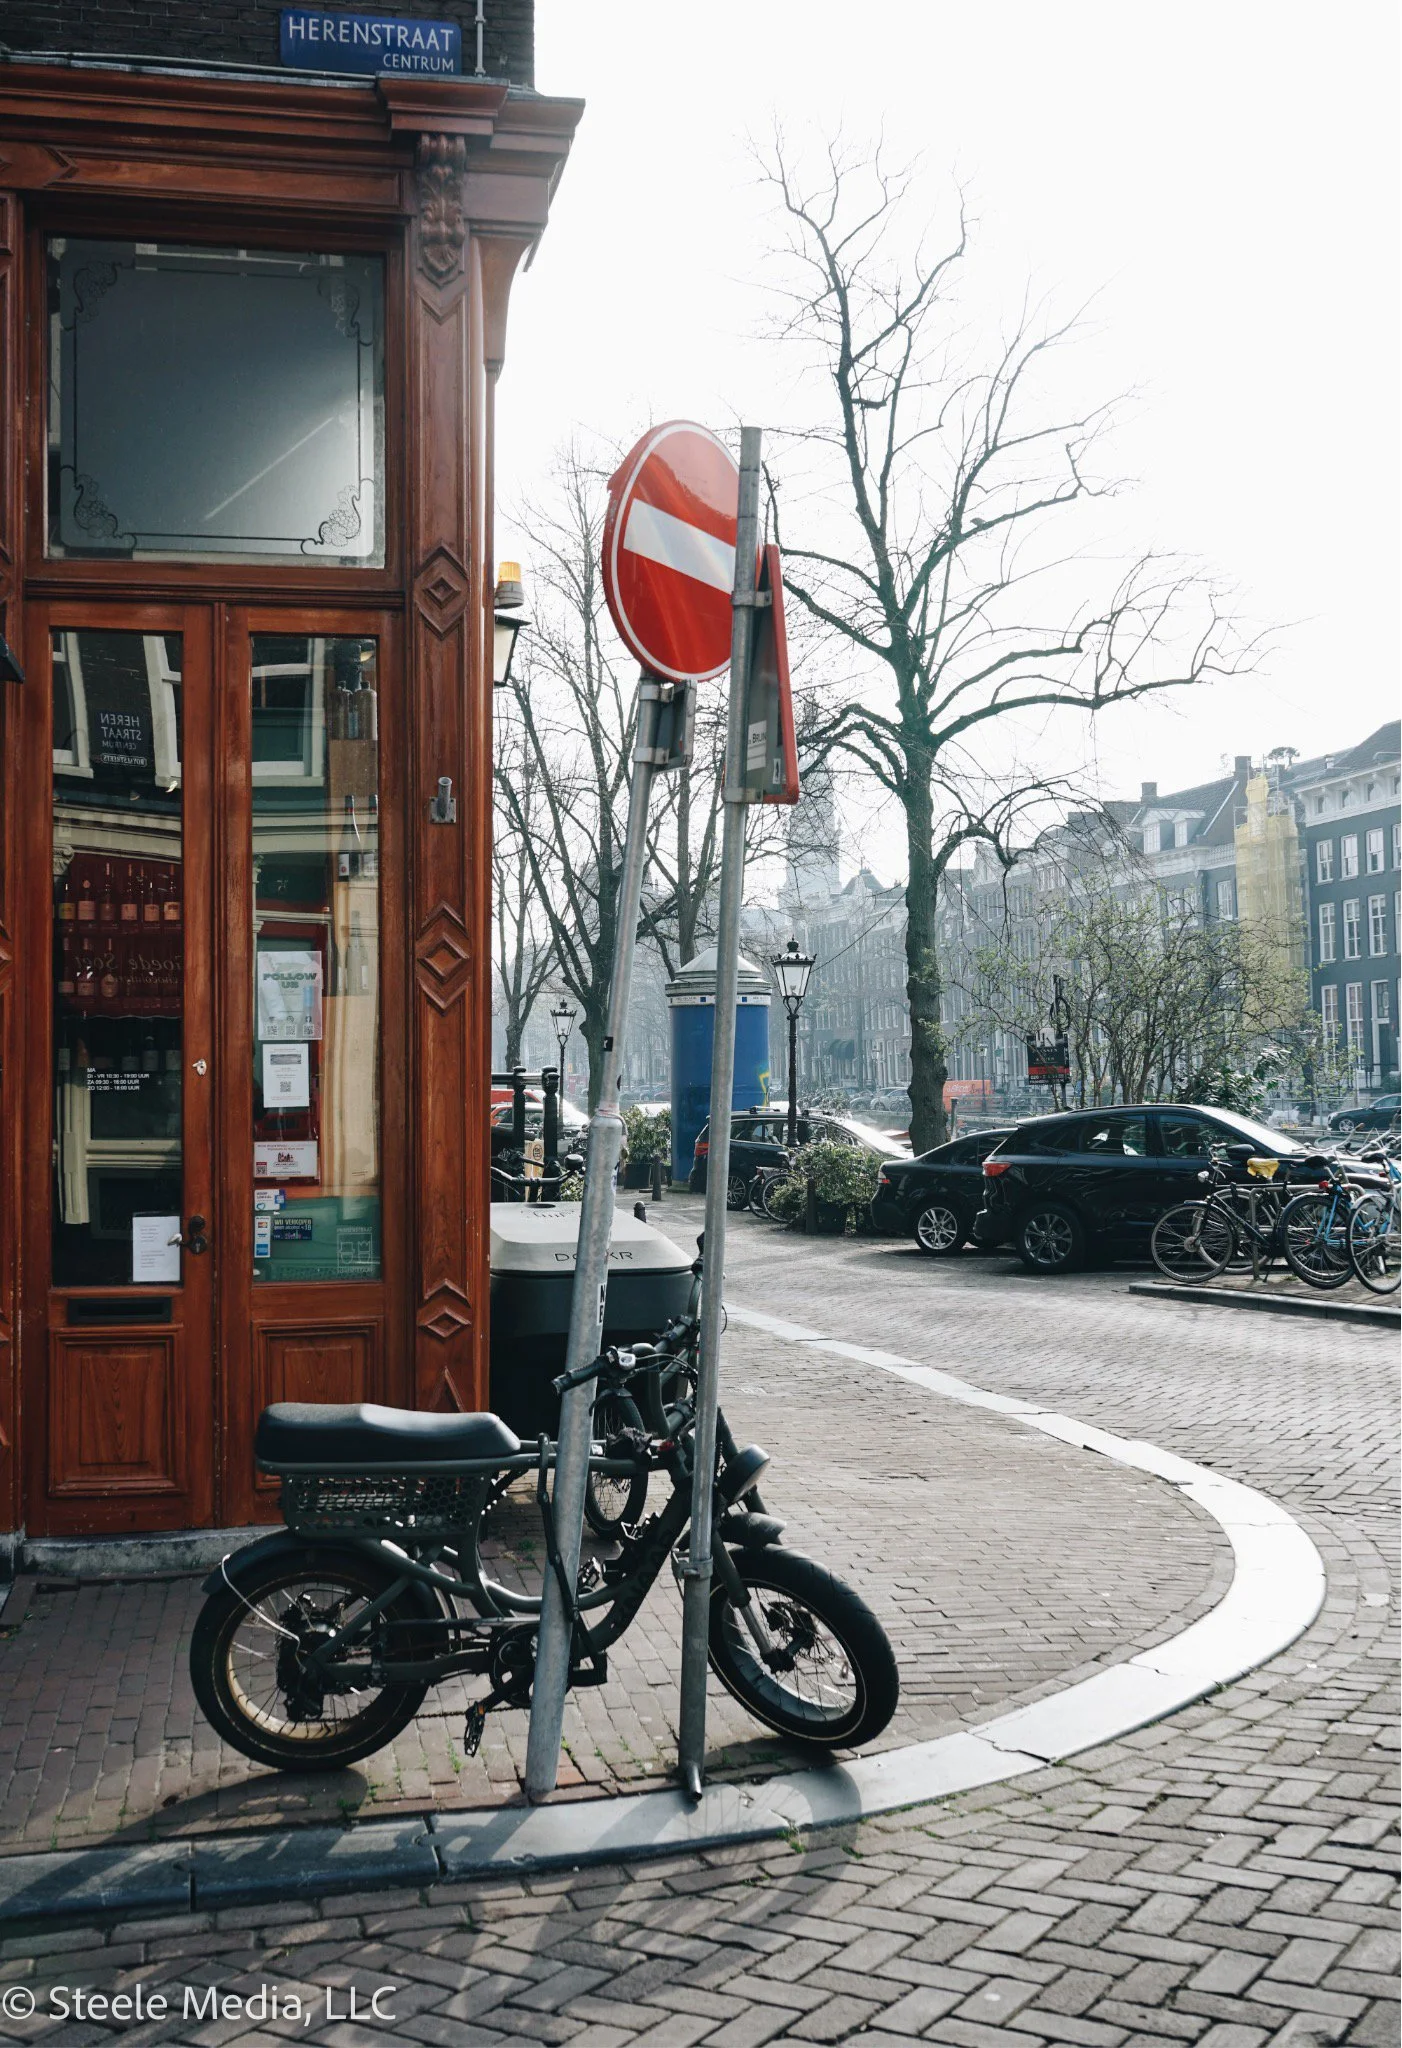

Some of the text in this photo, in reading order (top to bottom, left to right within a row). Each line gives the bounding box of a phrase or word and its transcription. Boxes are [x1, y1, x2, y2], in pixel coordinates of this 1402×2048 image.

[288, 16, 454, 52] HERENSTRAAT
[382, 53, 454, 73] CENTRUM
[262, 973, 317, 981] FOLLOW
[554, 1251, 633, 1262] DKR
